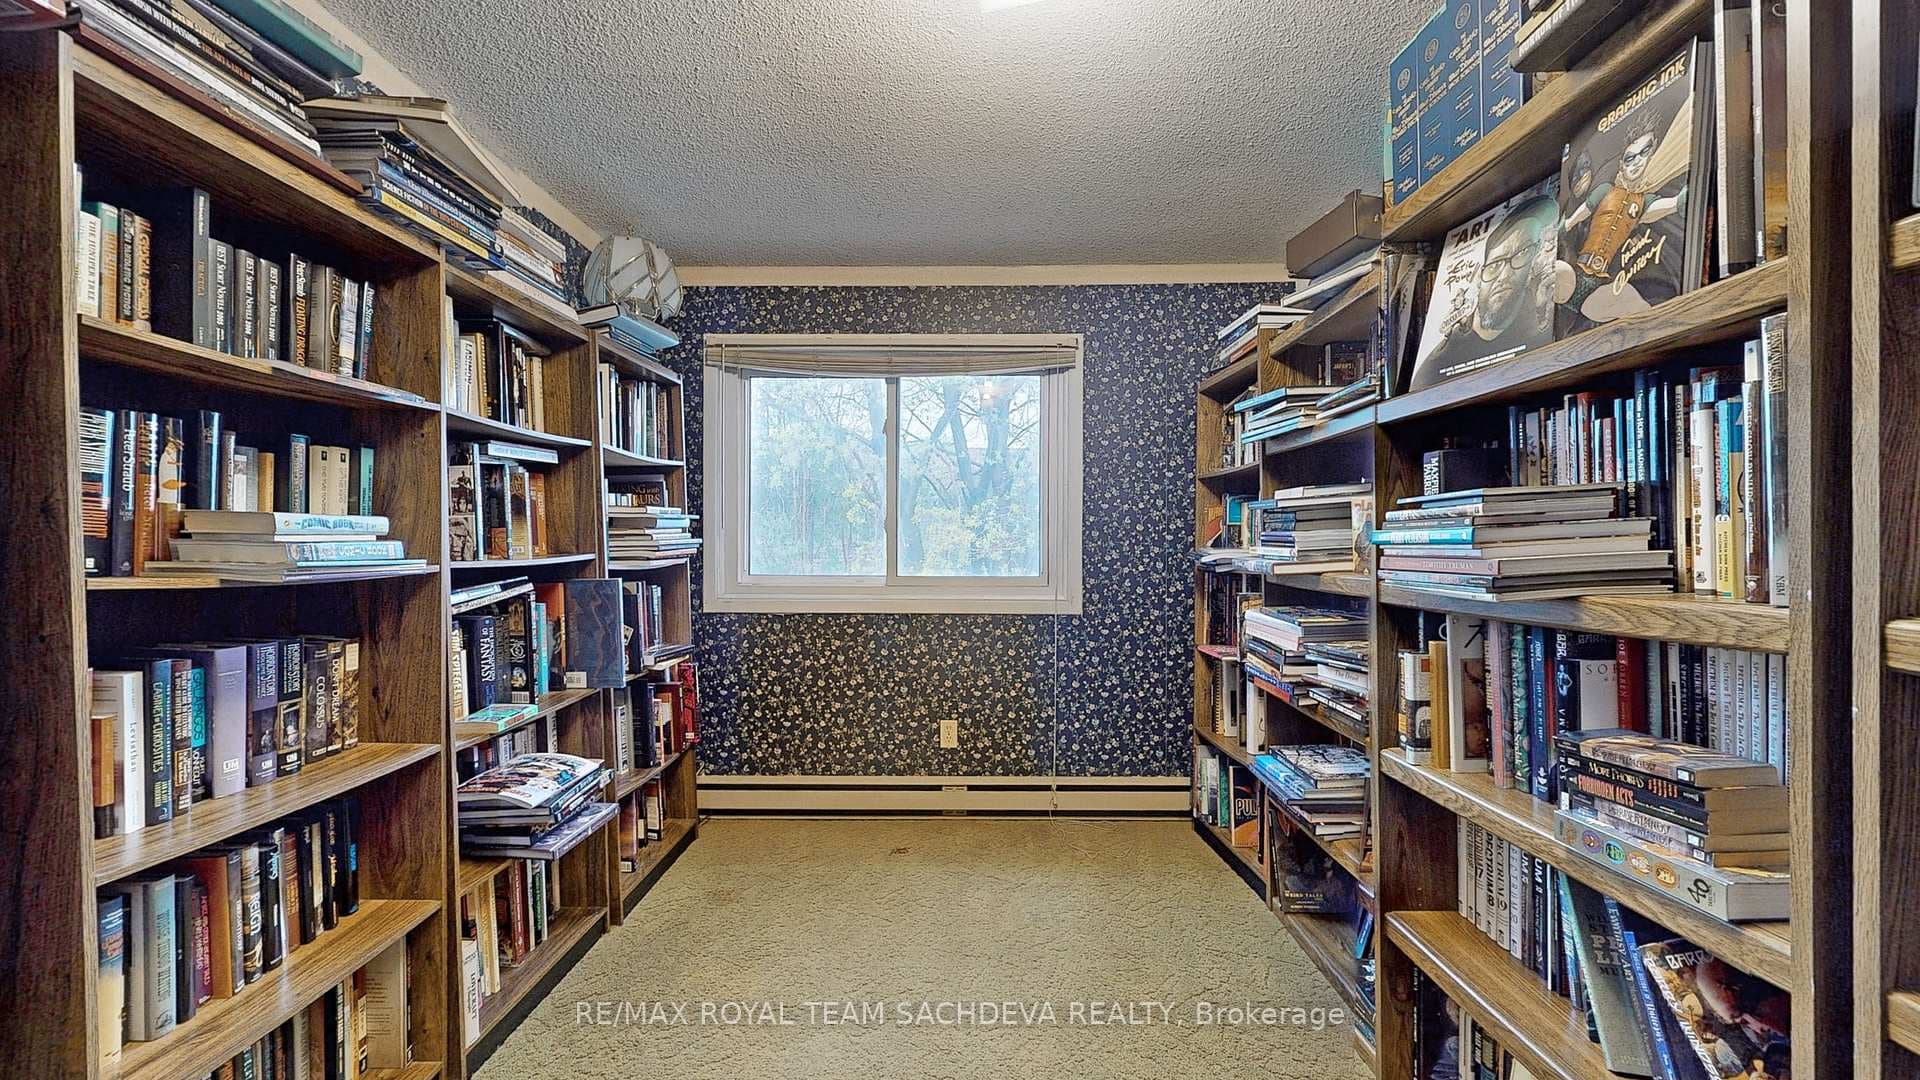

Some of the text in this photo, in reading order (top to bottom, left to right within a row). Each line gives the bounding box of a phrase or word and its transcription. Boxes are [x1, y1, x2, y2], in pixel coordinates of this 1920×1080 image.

[1597, 82, 1656, 132] GRAPHIC
[1657, 55, 1687, 88] INK
[1455, 214, 1496, 248] ART
[88, 221, 97, 302] THE JUNIPER TREE
[216, 245, 227, 263] BEST
[246, 257, 254, 273] BEST
[270, 267, 278, 283] BEST
[296, 297, 306, 334] FLOATING
[365, 288, 375, 334] Peter Straub
[121, 457, 135, 491] Straub
[1423, 463, 1432, 496] PARRIS
[1431, 458, 1440, 496] MAXFIE
[1637, 448, 1645, 481] SADNESS
[300, 517, 354, 531] COMIC BOOK
[1776, 575, 1785, 597] NBM
[450, 629, 462, 694] SAM SPIEGEL
[480, 636, 490, 683] FANTASY
[315, 675, 326, 729] COLOSSUS
[331, 691, 340, 722] DREAM
[1512, 697, 1522, 733] Maurice
[152, 682, 164, 773] CABINET CURIOSITIES
[129, 723, 138, 774] Leviathan
[1513, 733, 1523, 765] Sendak
[193, 749, 201, 785] VONNEGUT
[1588, 761, 1611, 778] MORE
[1235, 799, 1257, 817] PUL
[1577, 773, 1635, 808] FORBIDDEN ACTS
[1687, 877, 1712, 905] 40
[248, 891, 261, 936] REIGN
[1608, 907, 1627, 956] FANTASY
